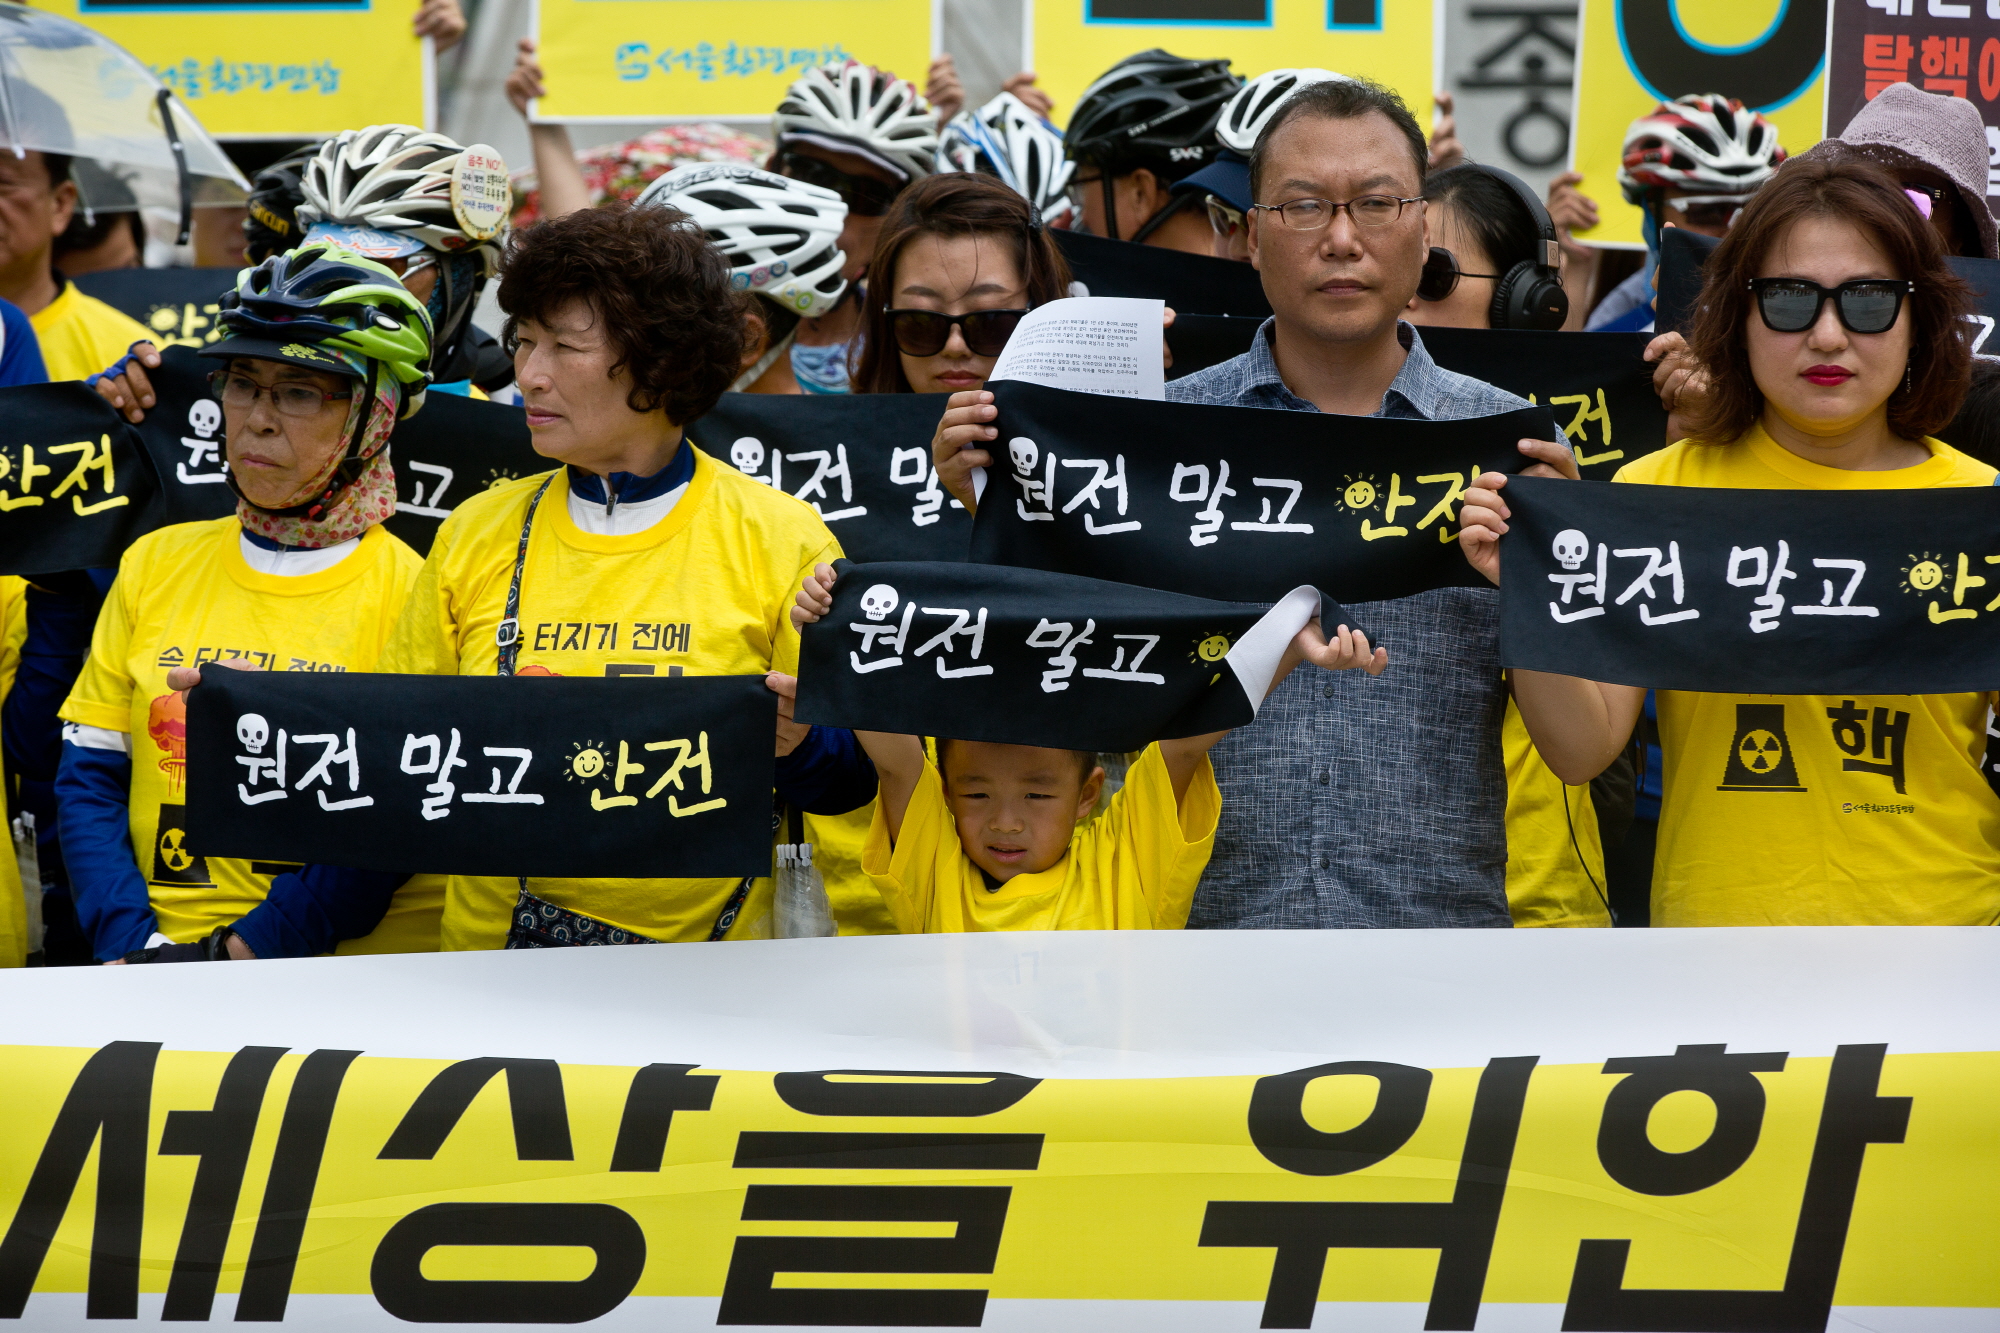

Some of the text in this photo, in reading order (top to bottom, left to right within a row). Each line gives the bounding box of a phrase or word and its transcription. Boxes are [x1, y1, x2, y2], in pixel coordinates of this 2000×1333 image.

[1530, 388, 1623, 466] 전
[1008, 436, 1142, 536] 원전
[1169, 459, 1315, 547] 말고
[1548, 528, 1700, 625] 원전
[1727, 540, 1880, 634] 말고
[533, 622, 619, 651] 터지기
[632, 622, 692, 653] 전에
[849, 583, 994, 678] 원전
[1026, 617, 1165, 693] 말고
[235, 713, 727, 821] 원전 말고 안전
[1826, 699, 1911, 795] 핵
[0, 1040, 1914, 1333] 세상을 위한
